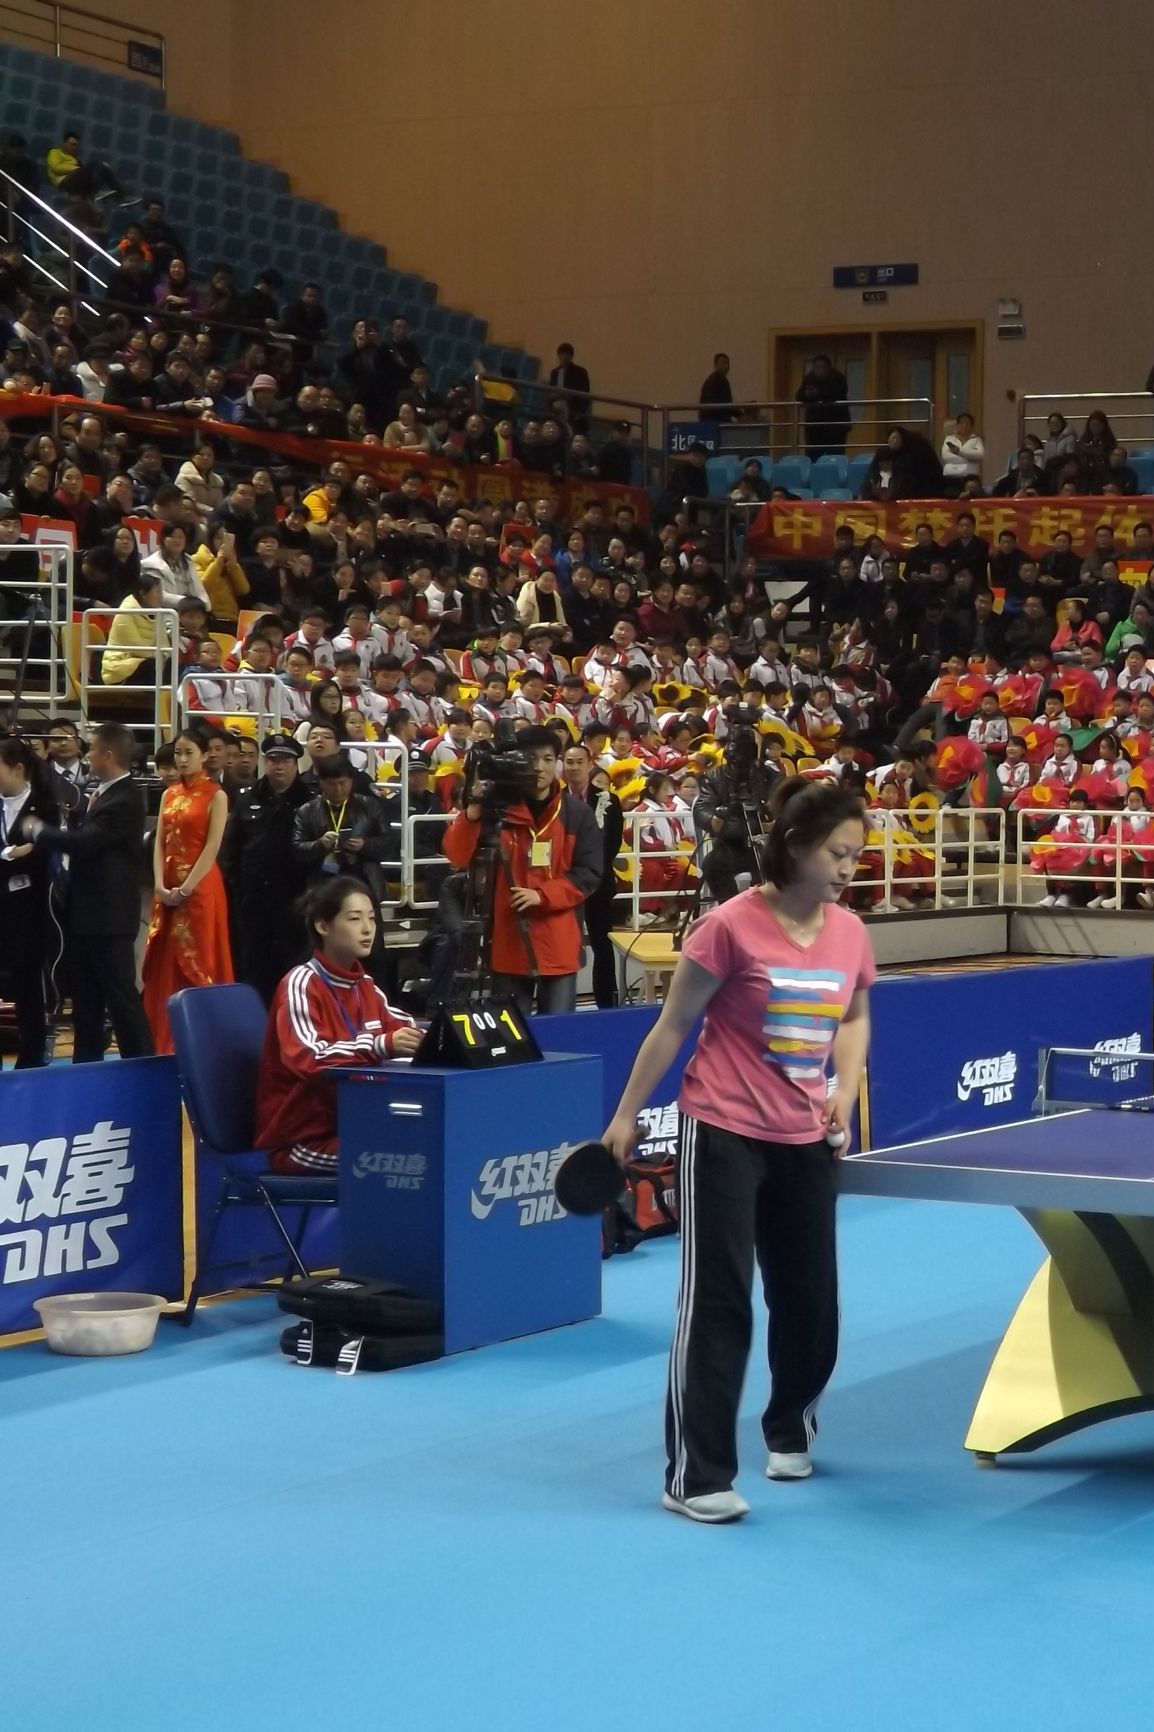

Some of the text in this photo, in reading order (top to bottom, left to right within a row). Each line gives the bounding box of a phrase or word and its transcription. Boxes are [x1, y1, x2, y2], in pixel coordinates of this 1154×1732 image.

[452, 1014, 476, 1046] 7
[500, 1009, 522, 1040] 1
[957, 1050, 1017, 1101] 红双喜
[982, 1083, 1015, 1106] DHS
[352, 1151, 427, 1178] 红双喜
[384, 1175, 425, 1190] DHS
[0, 1213, 128, 1284] DHS
